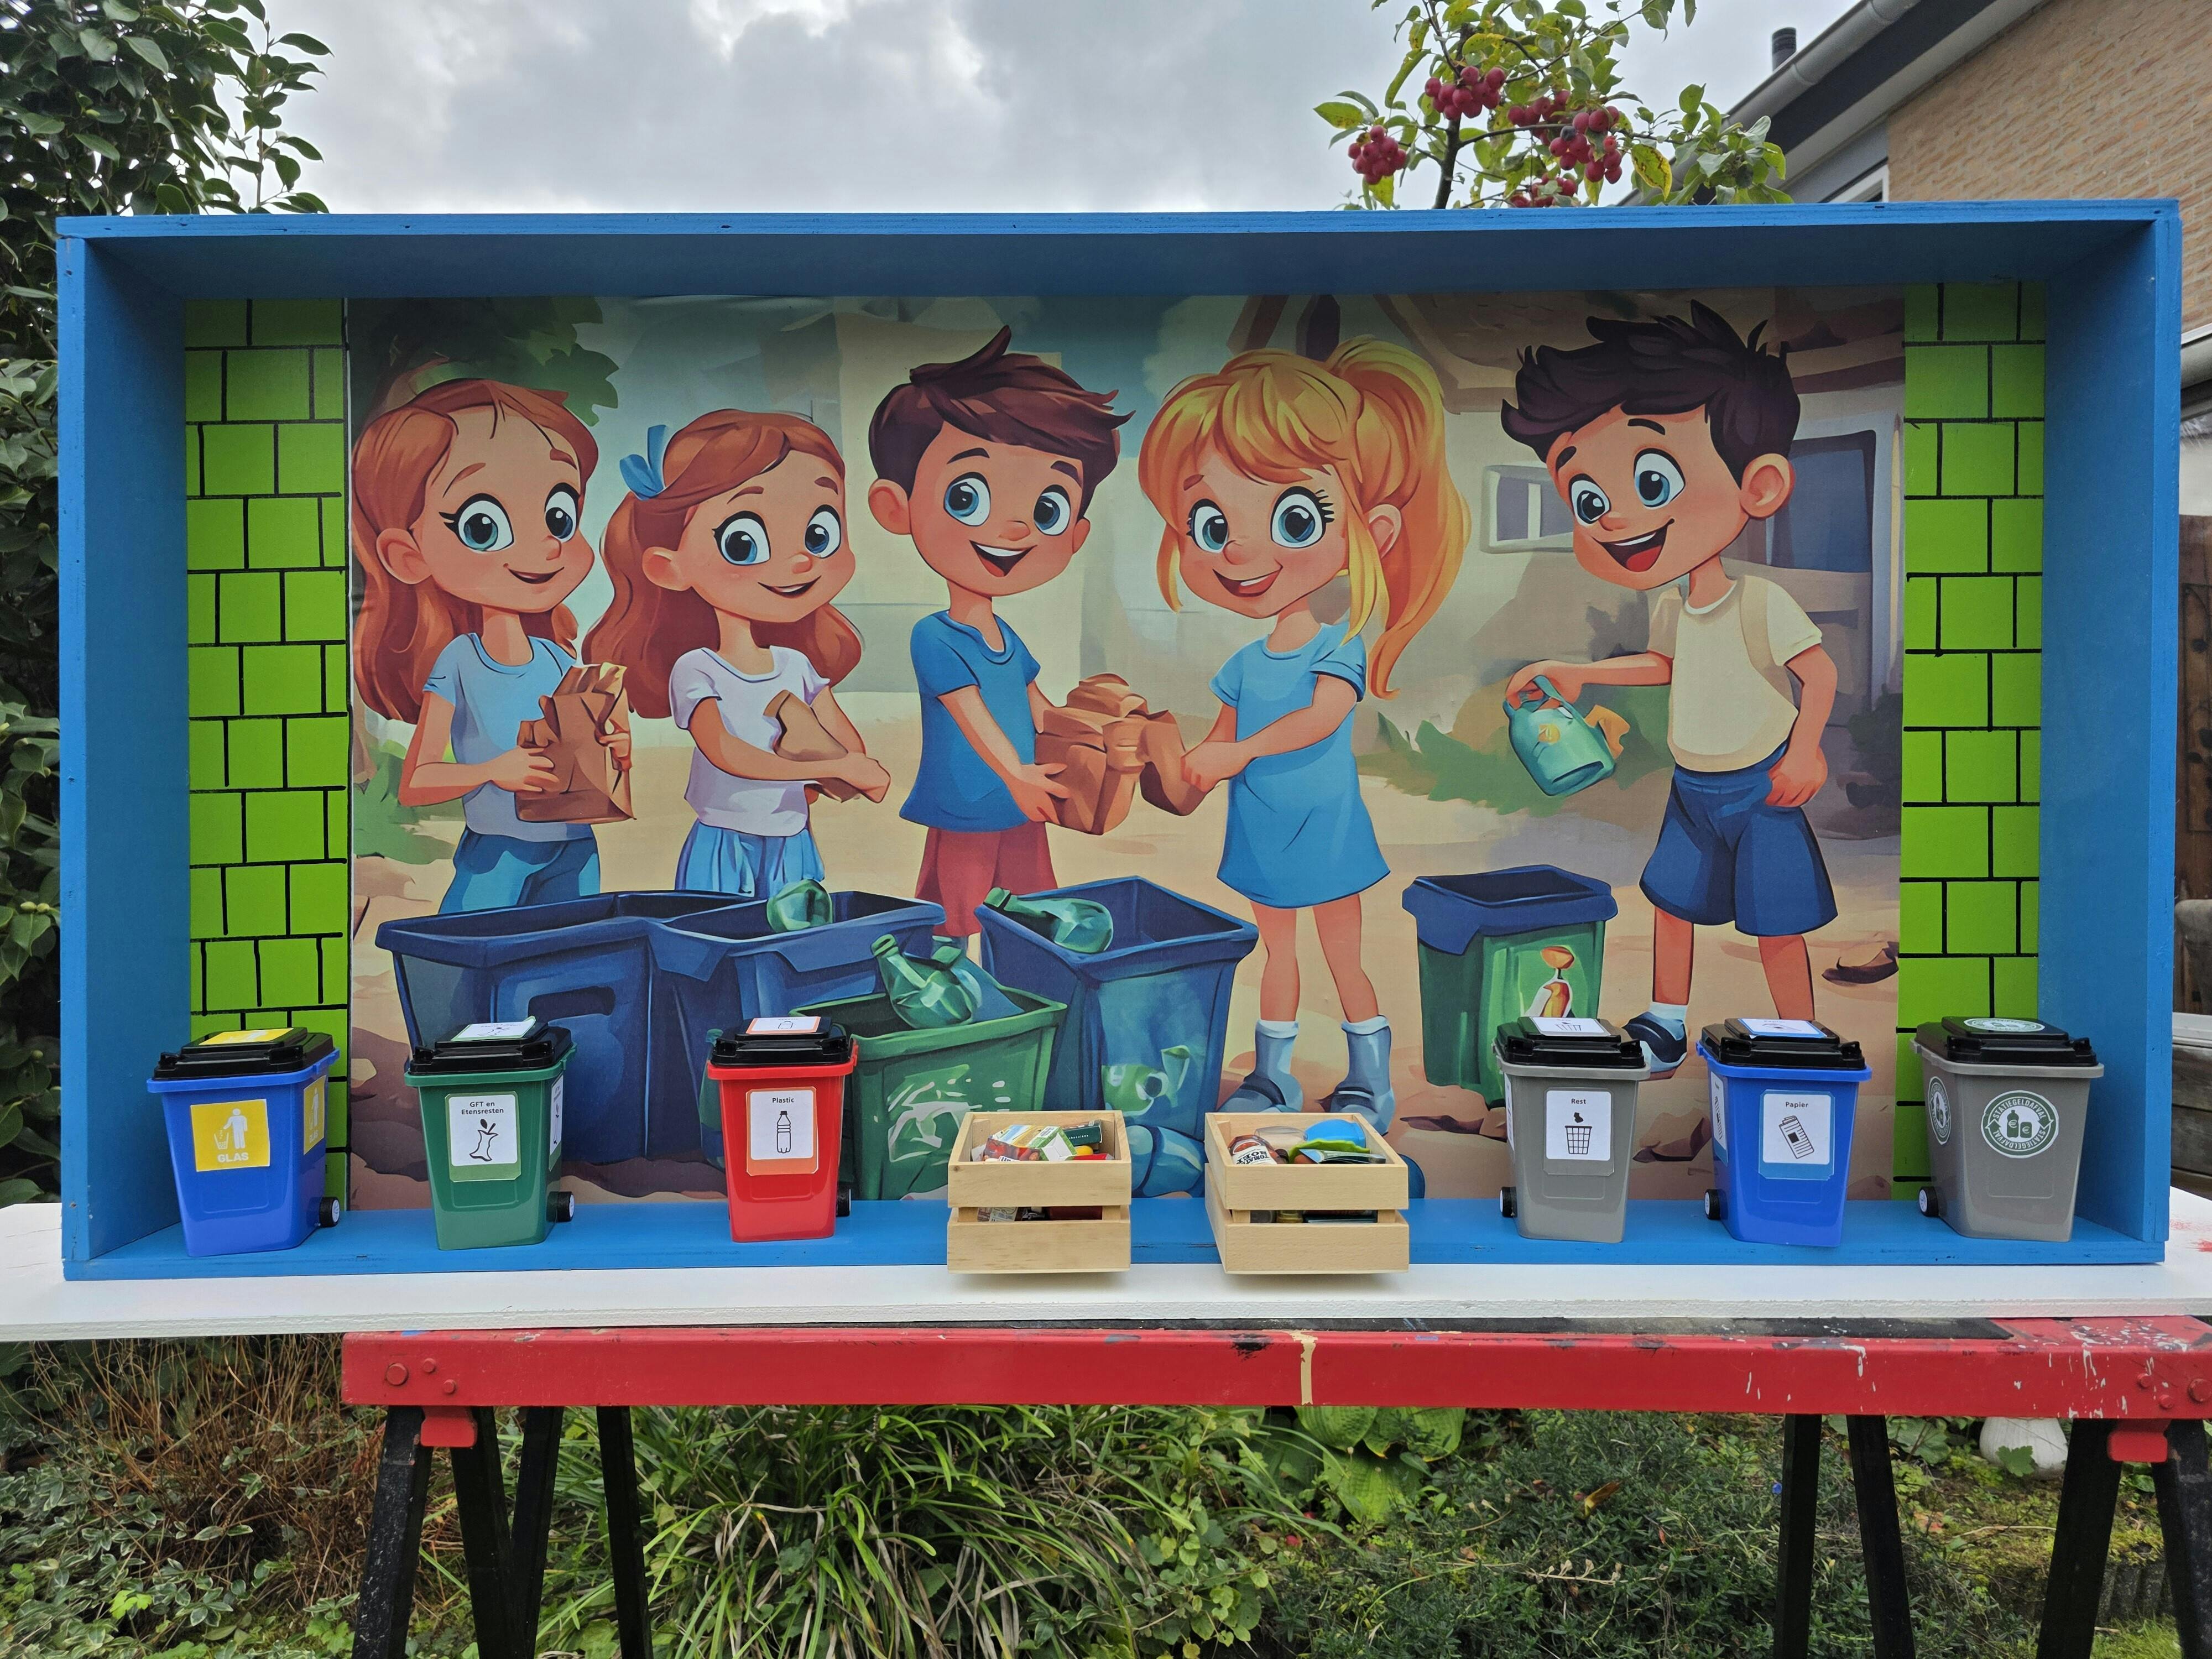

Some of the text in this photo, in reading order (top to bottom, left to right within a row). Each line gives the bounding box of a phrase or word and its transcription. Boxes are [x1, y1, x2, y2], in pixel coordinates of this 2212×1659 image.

[1992, 1098, 2047, 1119] STATIEGELDAFVAL
[1992, 1129, 2046, 1149] STATIEGELDAFVAL
[217, 1152, 249, 1162] GLAS
